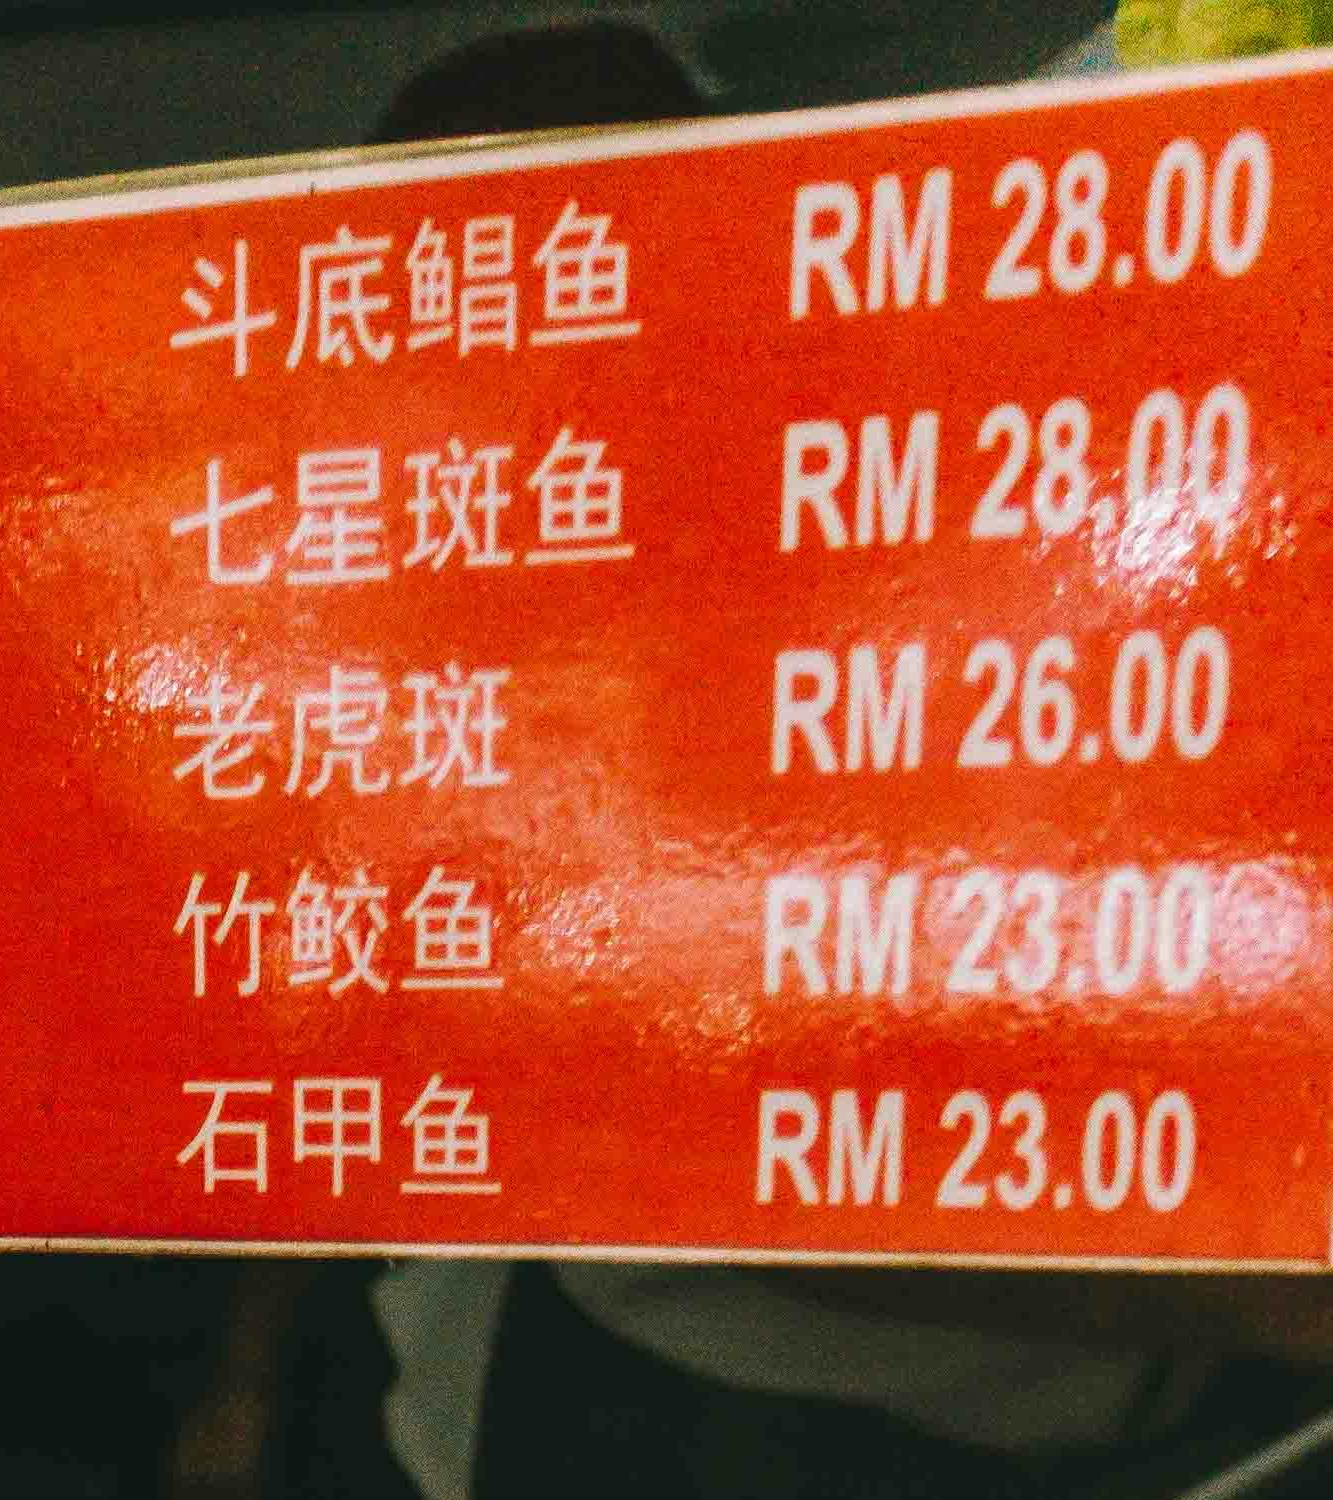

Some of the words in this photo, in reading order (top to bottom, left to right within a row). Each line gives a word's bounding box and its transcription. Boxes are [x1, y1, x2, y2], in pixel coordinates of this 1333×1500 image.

[169, 200, 642, 377] 斗底鲳鱼
[790, 170, 952, 317] RM
[985, 130, 1272, 300] 28.00
[170, 425, 636, 586] 七星斑鱼
[780, 410, 939, 552] RM
[969, 382, 1253, 542] 28.00
[173, 662, 513, 800] 老虎斑
[771, 640, 929, 775] RM
[957, 626, 1231, 769] 26.00
[173, 864, 504, 997] 竹鲛鱼
[763, 870, 918, 998] RM
[945, 862, 1211, 998] 23.00
[177, 1074, 502, 1197] 石甲鱼
[755, 1089, 906, 1207] RM
[936, 1089, 1197, 1213] 23.00
